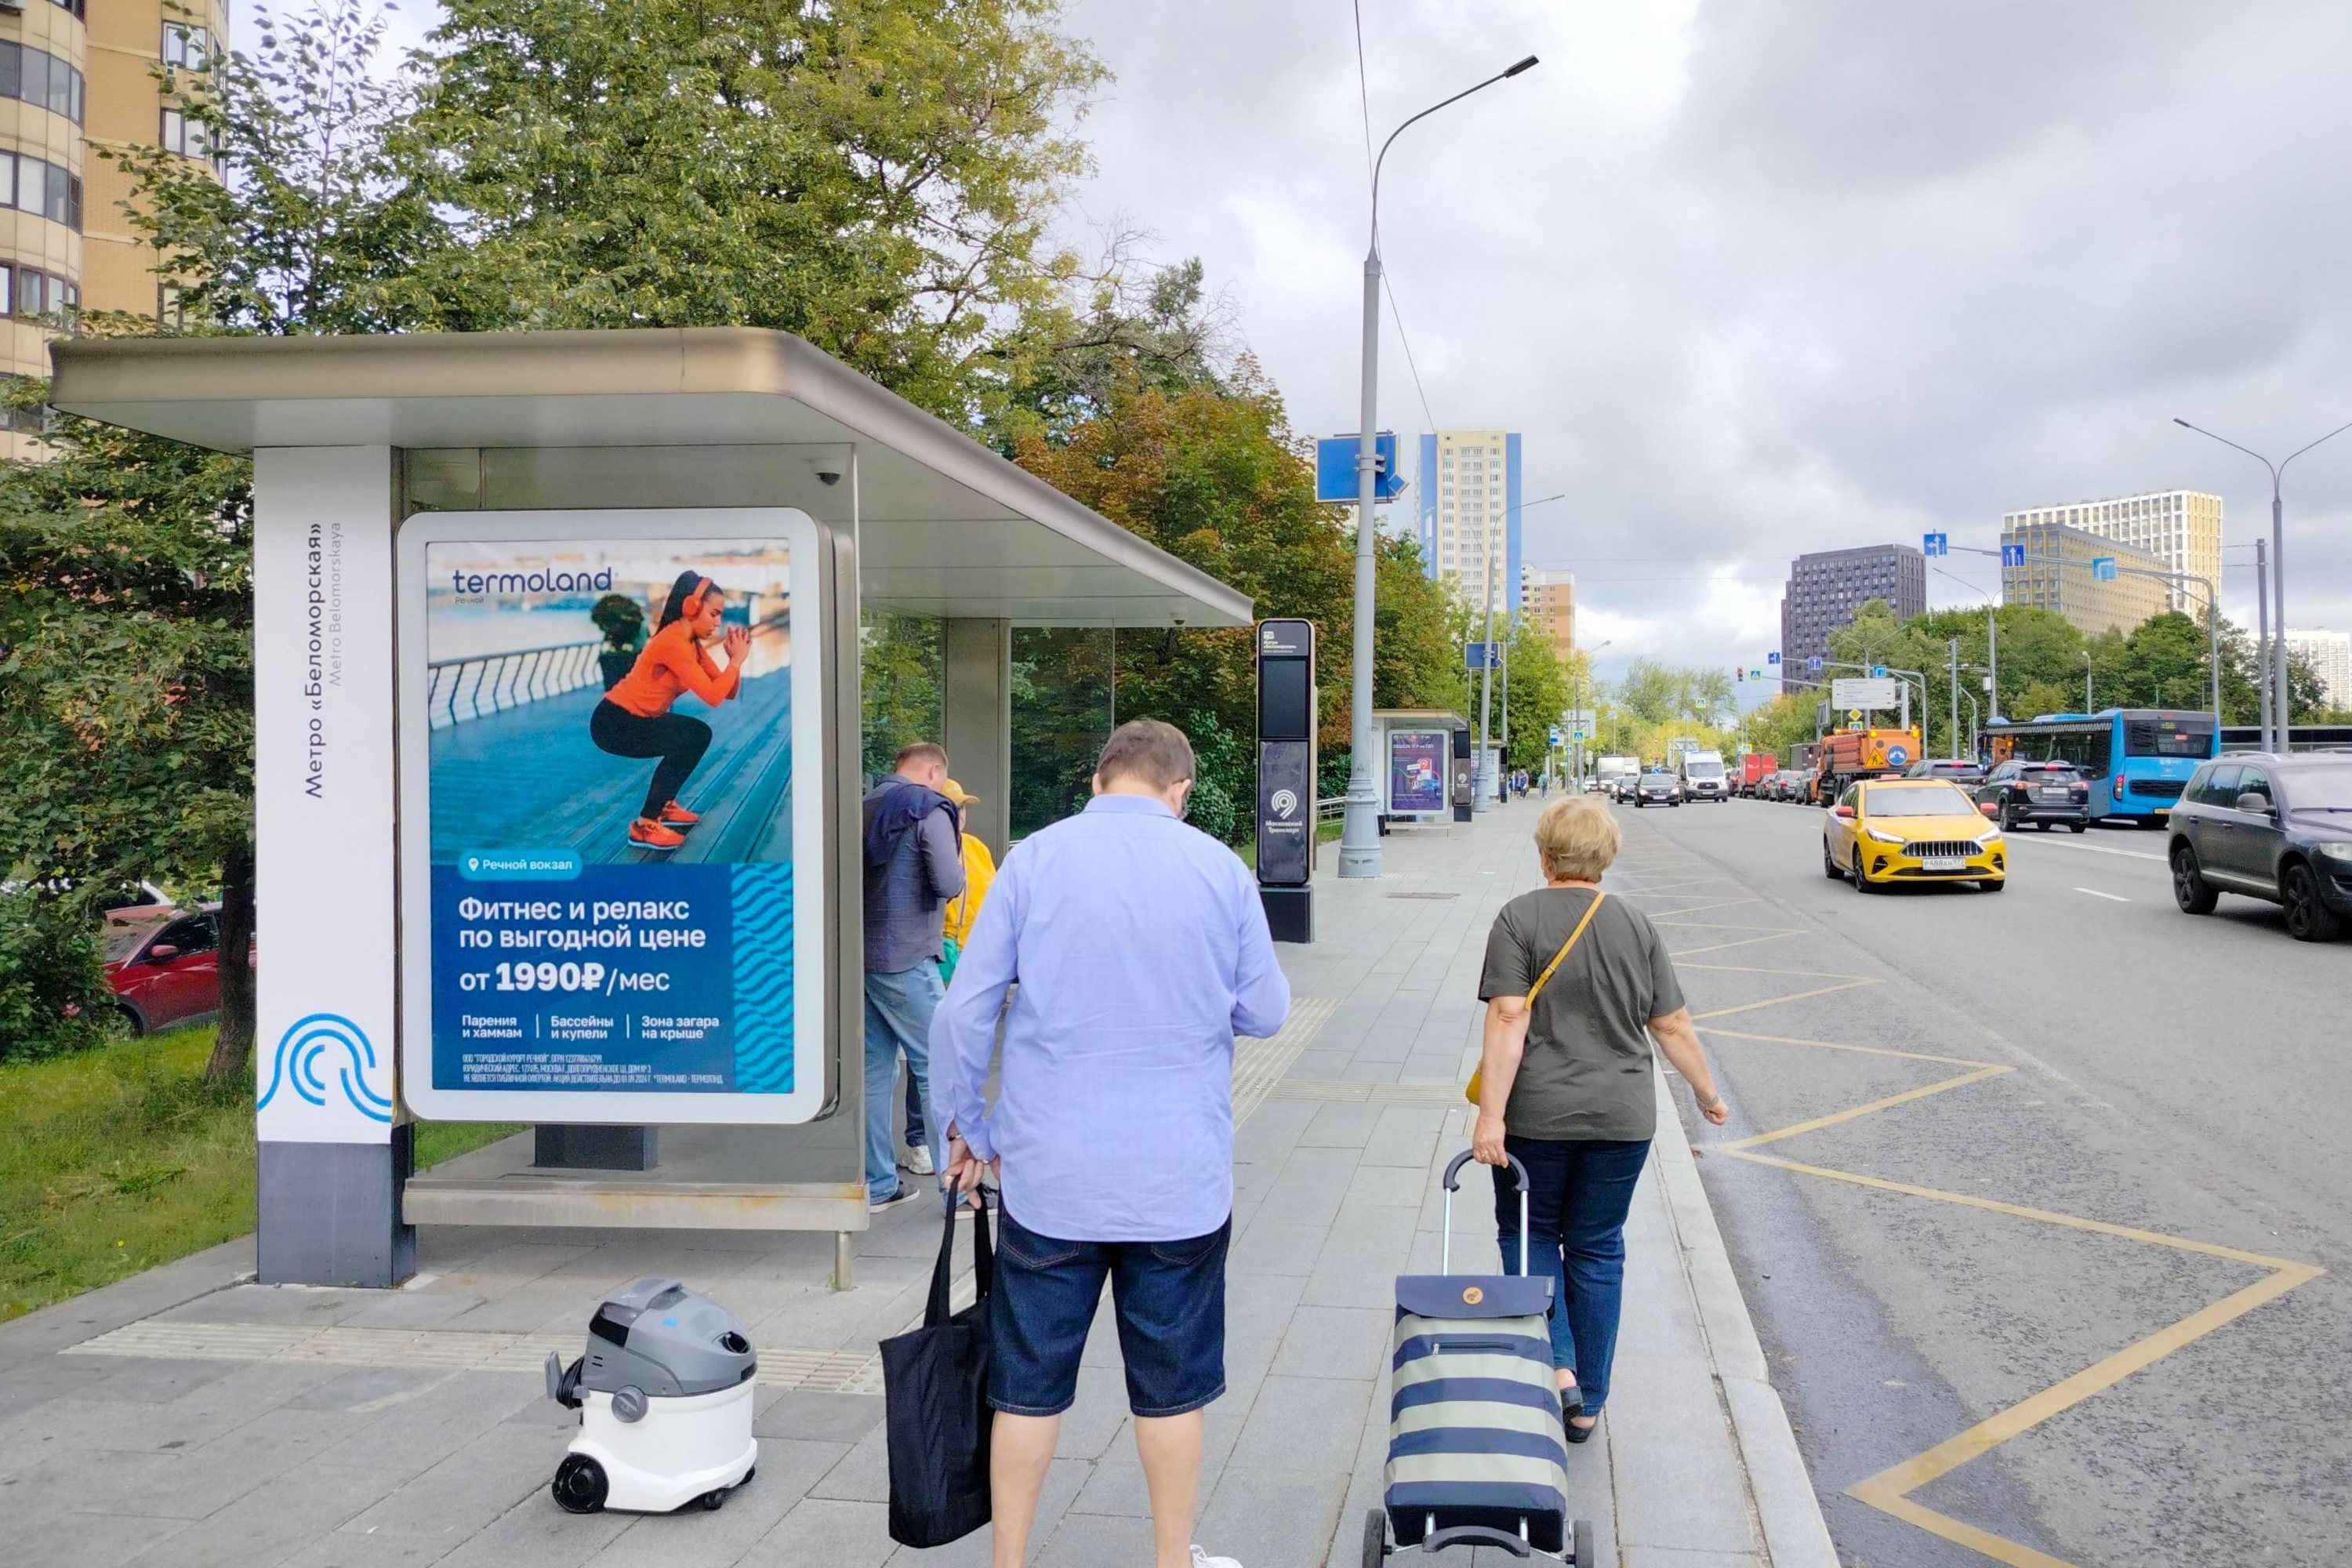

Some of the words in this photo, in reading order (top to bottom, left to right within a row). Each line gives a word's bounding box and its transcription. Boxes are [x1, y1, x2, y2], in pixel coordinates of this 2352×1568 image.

[328, 522, 343, 633] Belomorskaya
[452, 567, 612, 593] termoland
[304, 523, 325, 710] «Беломорская»
[329, 637, 342, 687] Metro
[305, 717, 326, 798] Метро
[482, 858, 528, 870] Речной
[529, 861, 572, 870] вокзал
[459, 896, 562, 921] Фитнес
[569, 902, 585, 920] и
[593, 901, 690, 925] релакс
[459, 929, 493, 949] по
[499, 924, 631, 951] выгодной
[639, 929, 706, 951] цене
[459, 973, 490, 991] от
[462, 1015, 517, 1027] Парения
[550, 1015, 614, 1027] Бассейны
[641, 1016, 673, 1027] Зона
[676, 1017, 720, 1029] загара
[462, 1029, 470, 1038] и
[473, 1028, 522, 1038] хаммам
[551, 1029, 560, 1039] и
[561, 1029, 608, 1041] купели
[641, 1029, 658, 1039] на
[660, 1029, 704, 1041] крыше
